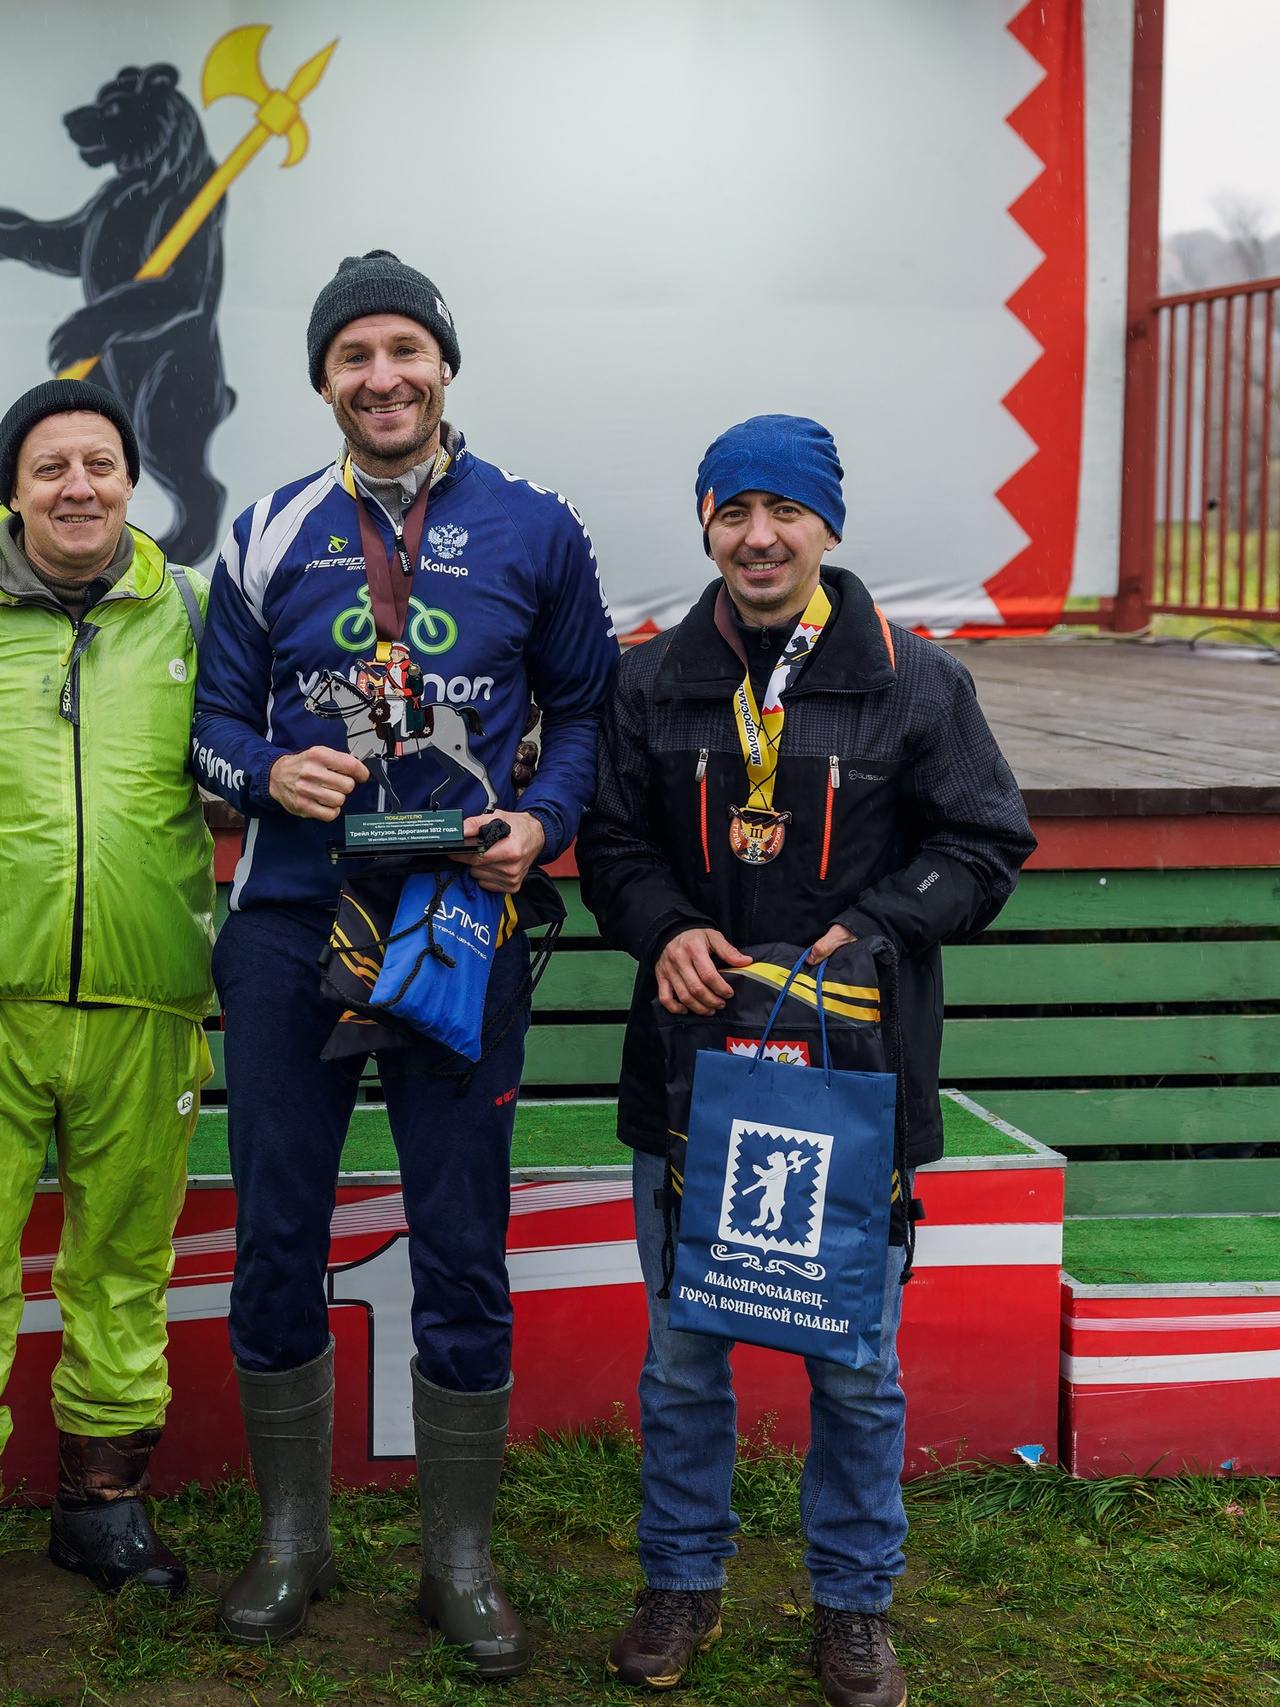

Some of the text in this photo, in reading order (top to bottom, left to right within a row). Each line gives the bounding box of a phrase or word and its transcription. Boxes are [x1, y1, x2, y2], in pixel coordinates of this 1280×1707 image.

[304, 556, 366, 573] MERID
[420, 555, 469, 578] Kaluga
[397, 828, 429, 836] Дорогами
[704, 1270, 829, 1310] МАЛОЯРОСЛАВЕЦ-
[678, 1285, 850, 1334] ГОРОД ВОИНСКОЙ СЛАВЫ!
[328, 1232, 417, 1460] 1
